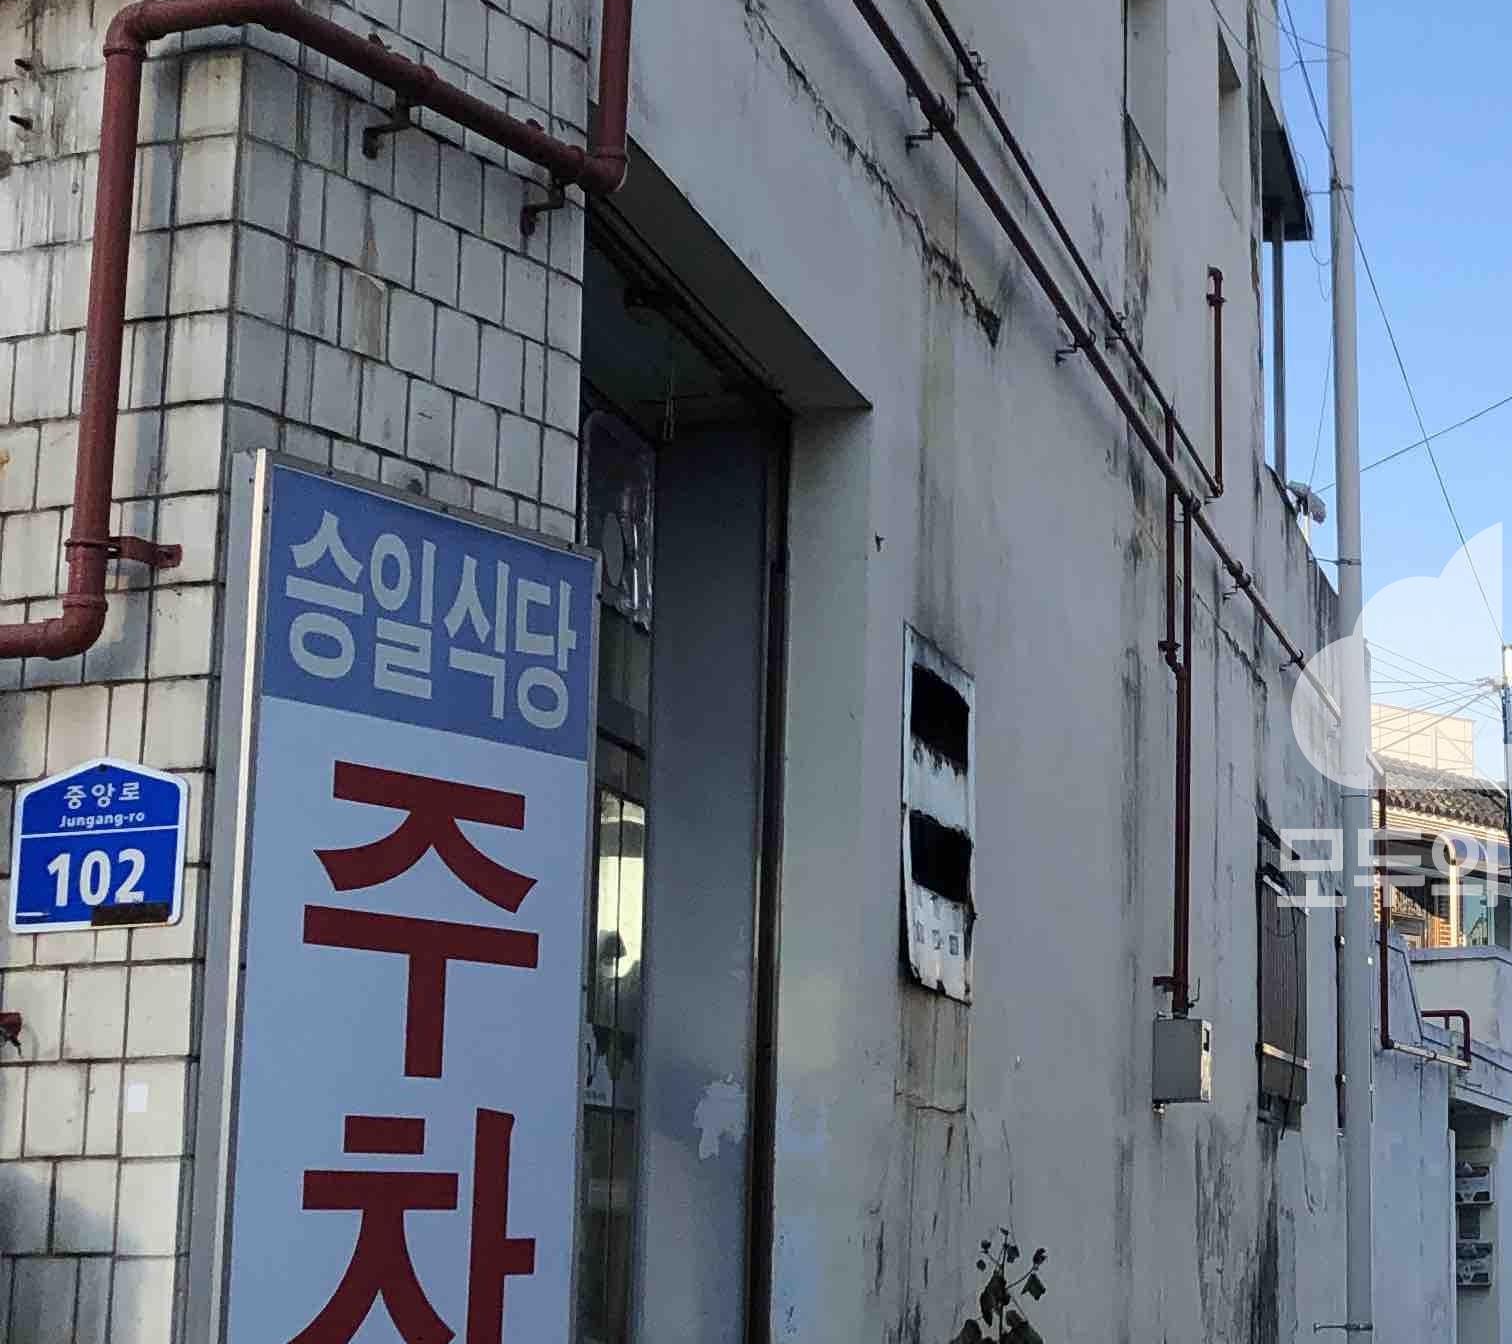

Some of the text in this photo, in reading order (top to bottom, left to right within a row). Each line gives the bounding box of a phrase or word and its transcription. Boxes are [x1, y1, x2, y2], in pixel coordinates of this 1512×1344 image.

[285, 509, 578, 729] 승일식당
[63, 782, 140, 810] 중앙로
[59, 812, 145, 828] Jungang-ro
[47, 848, 146, 907] 102
